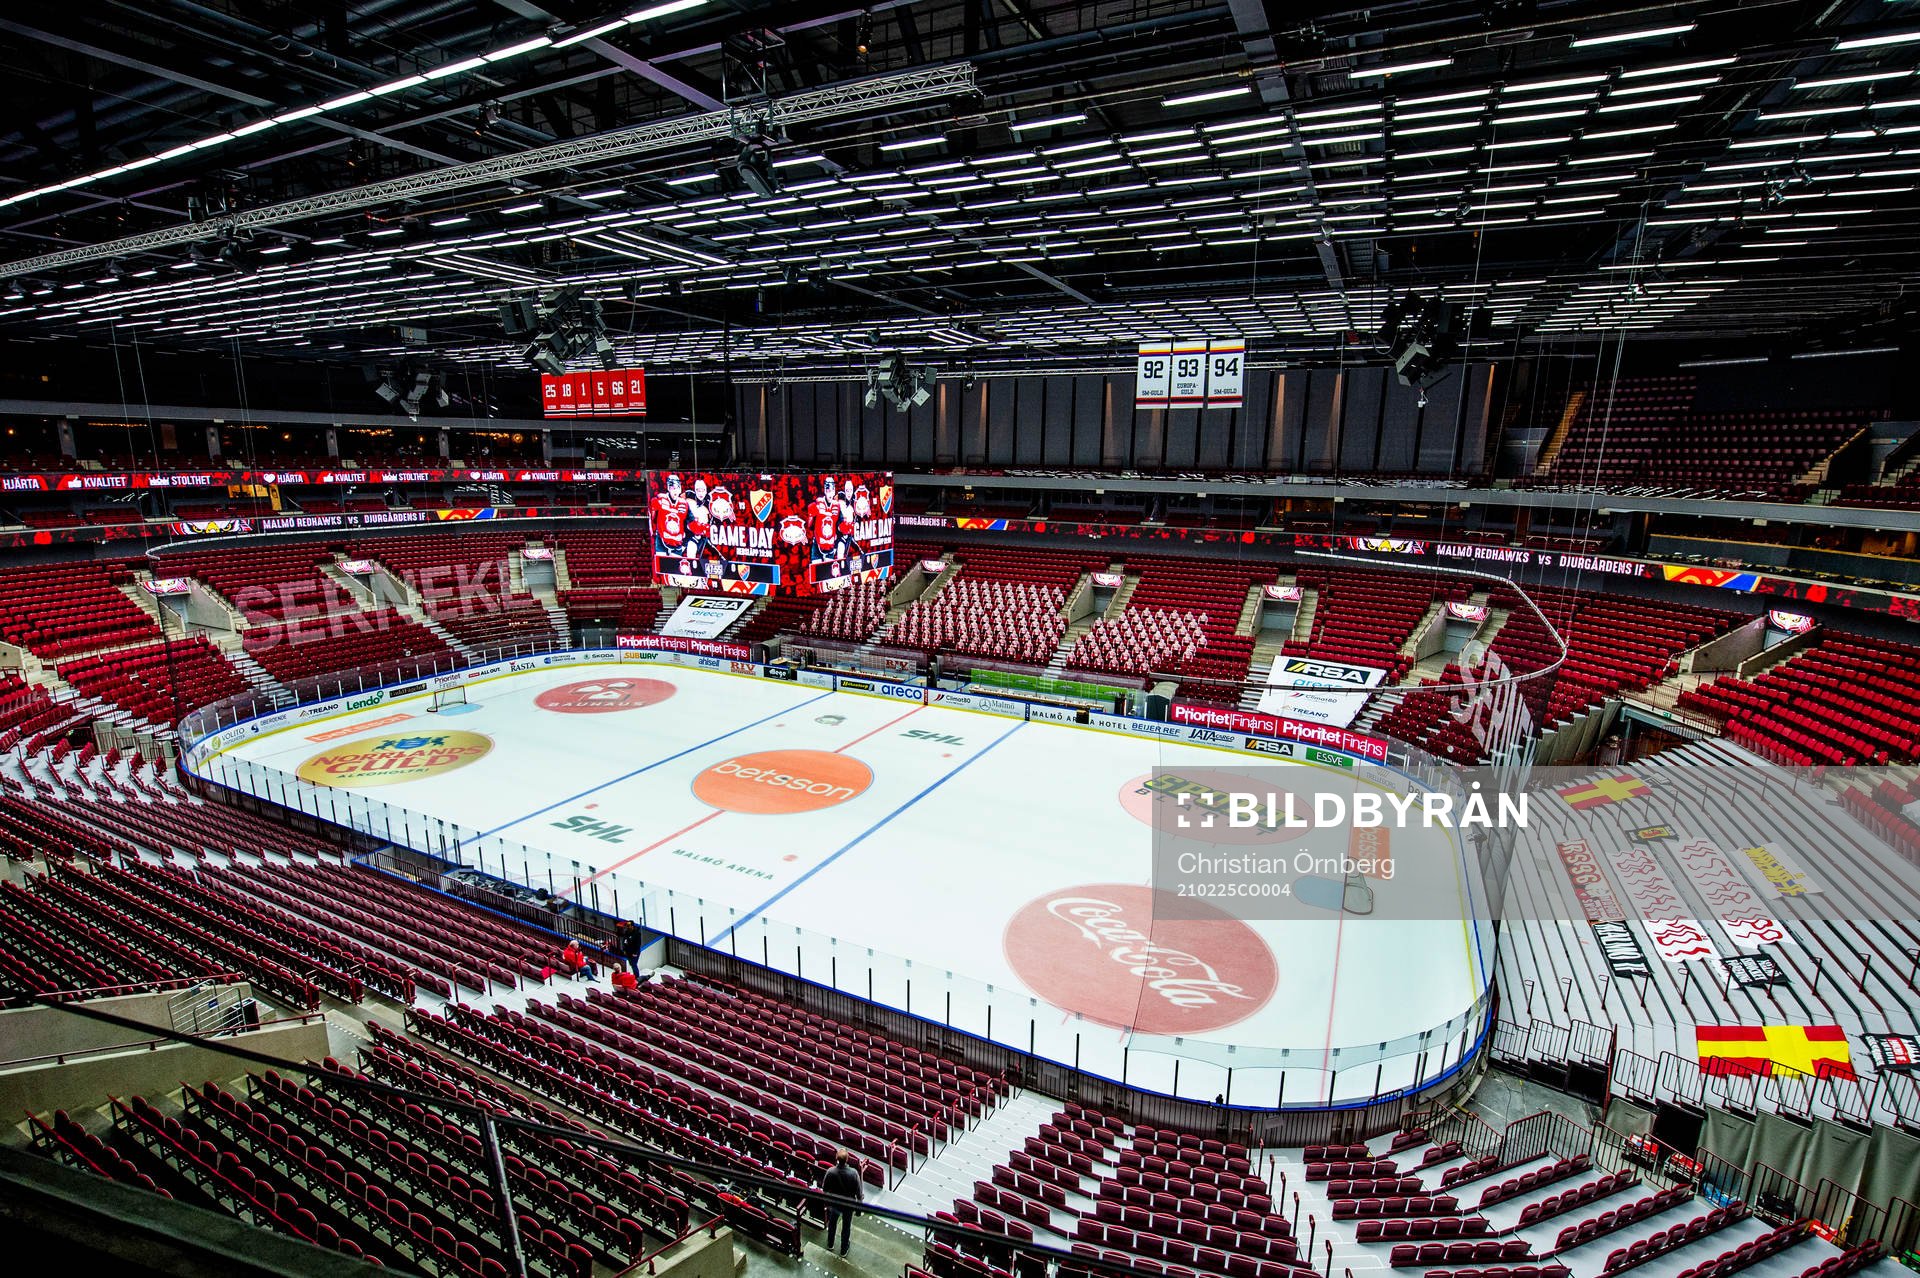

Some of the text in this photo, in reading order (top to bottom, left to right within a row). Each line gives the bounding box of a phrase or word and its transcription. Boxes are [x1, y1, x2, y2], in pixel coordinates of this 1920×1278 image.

[1143, 361, 1163, 378] 92
[1178, 359, 1199, 377] 93
[1215, 358, 1238, 377] 94
[545, 384, 556, 398] 25
[562, 383, 571, 397] 18
[581, 382, 586, 396] 1
[597, 382, 604, 396] 5
[612, 381, 624, 395] 66
[631, 380, 640, 394] 21
[84, 476, 126, 488] KVALITET
[171, 475, 211, 486] STOLTHET
[277, 473, 303, 484] HJÄRTA
[335, 473, 365, 482] KVALITET
[398, 472, 429, 481] STOLTHET
[481, 471, 504, 480] HJÄRTA
[532, 472, 558, 480] KVALITET
[587, 472, 614, 480] STOLTHET
[3, 478, 40, 490] HJÄRTA
[263, 511, 426, 530] MALMÖ REDHAWKS VS DJURGÅRDENS IF
[899, 516, 940, 527] DJURGÅRDENS
[941, 518, 947, 527] IF
[709, 524, 774, 548] GAME DAY
[854, 519, 877, 541] GAME
[878, 517, 892, 538] DAY
[1437, 544, 1645, 576] MALMÖ REDHAWKS VS DJURGÅRDENS IF
[701, 599, 739, 610] RSA
[620, 636, 686, 649] Prioritet Finans
[691, 641, 747, 657] Prioritet Finans
[624, 652, 658, 660] SUBWAY
[698, 658, 720, 667] ahlsell
[510, 662, 536, 672] RASTA
[1302, 663, 1364, 683] RSA
[434, 673, 461, 685] Prioritet
[881, 684, 922, 700] areco
[309, 704, 339, 715] TREANO
[346, 694, 381, 711] Lendo
[991, 699, 1014, 709] Malmö
[1032, 709, 1063, 721] MALMÖ
[1066, 715, 1095, 726] ARA
[1099, 720, 1127, 730] HOTEL
[1175, 706, 1273, 731] Prioritet Finans
[1293, 707, 1329, 718] TREANO
[221, 727, 245, 741] VOLITO
[1131, 722, 1181, 736] BEIJER REF
[1188, 728, 1216, 742] JATA
[899, 730, 965, 746] SHL
[1283, 721, 1382, 757] Prioritet Finans
[312, 745, 486, 766] NORRLANDS
[1255, 742, 1292, 755] RSA
[326, 754, 458, 774] GULD
[1316, 752, 1343, 767] ESSVE
[336, 767, 430, 778] ALKOHOLFRI
[712, 760, 855, 800] betsson
[550, 815, 634, 844] SHL
[672, 848, 774, 880] MALMÖ ARENA
[1721, 907, 1783, 941] UPP
[1047, 897, 1256, 1009] Coca-Cola
